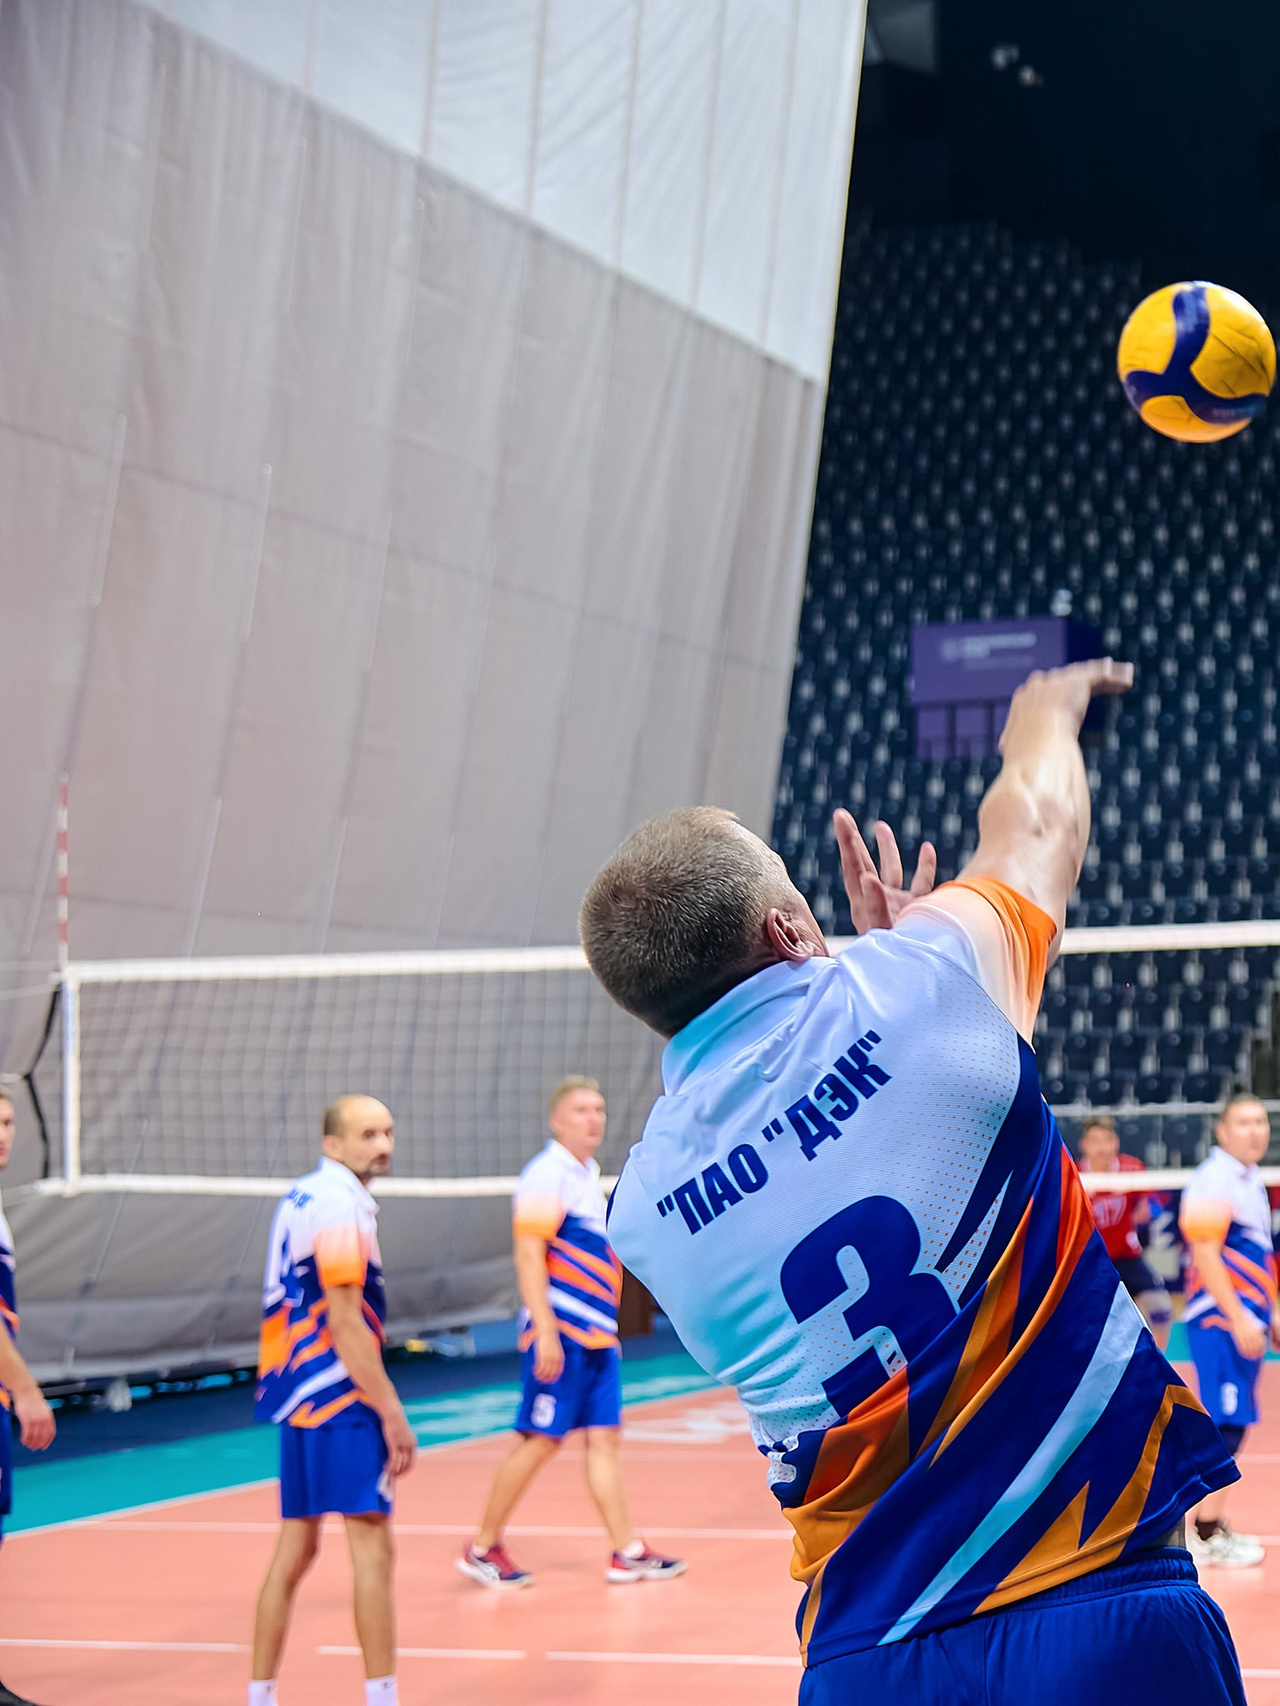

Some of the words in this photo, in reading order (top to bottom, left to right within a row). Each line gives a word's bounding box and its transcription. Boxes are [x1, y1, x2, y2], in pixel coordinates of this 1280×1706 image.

[656, 1143, 769, 1236] "ПАО
[762, 1029, 893, 1162] "ДЭК"
[780, 1195, 961, 1419] 3
